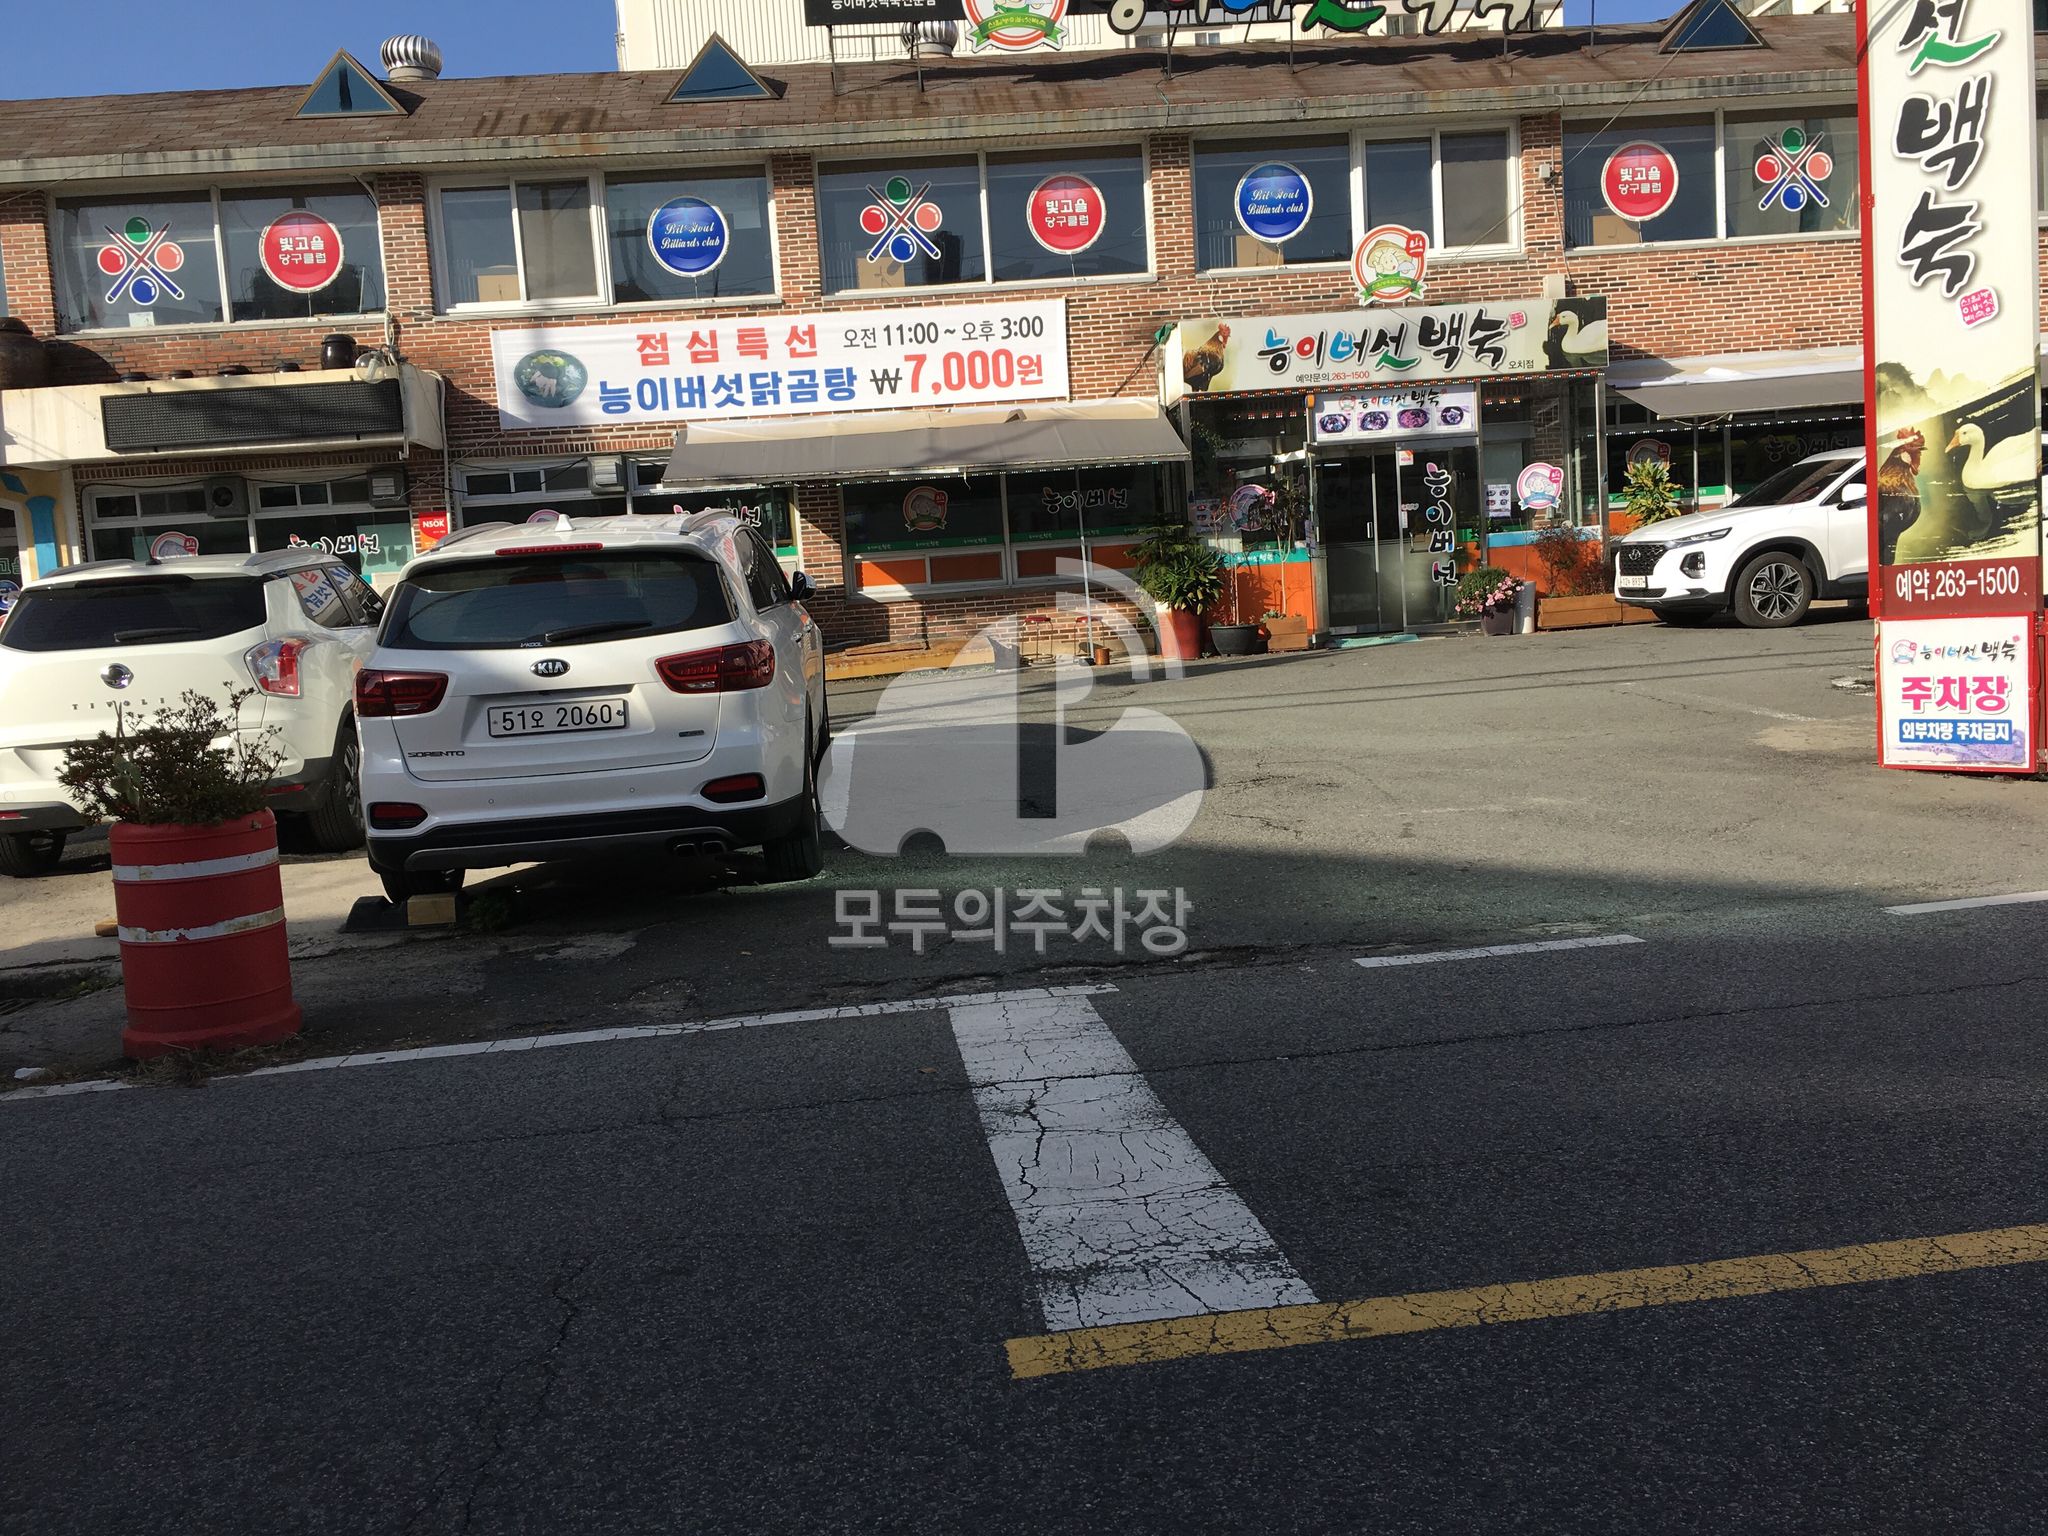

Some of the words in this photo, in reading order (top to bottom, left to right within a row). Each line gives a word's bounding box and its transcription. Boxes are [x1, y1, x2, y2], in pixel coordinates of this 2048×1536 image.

[1620, 165, 1661, 182] 빛고을
[1618, 182, 1662, 195] 당구클럽
[1045, 198, 1088, 214] 빛고을
[1246, 203, 1284, 216] Billiards
[1285, 202, 1304, 213] club
[1044, 214, 1089, 229] 당구클럽
[279, 235, 325, 251] 빛고을
[660, 236, 700, 250] Billiards
[701, 235, 720, 247] club
[278, 252, 327, 266] 당구클럽
[843, 327, 877, 348] 오전
[883, 321, 939, 346] 11:00
[961, 321, 995, 342] 오후
[1000, 315, 1044, 340] 3:00
[1508, 360, 1535, 370] 오치점
[599, 366, 857, 414] 능이버섯닭곰탕
[422, 520, 445, 528] NSOK
[536, 661, 565, 674] KIA
[1901, 676, 2009, 712] 주차장
[502, 710, 545, 731] 51오
[555, 704, 612, 727] 2060
[1902, 721, 1953, 740] 외부차량
[1956, 721, 2010, 740] 주차금지
